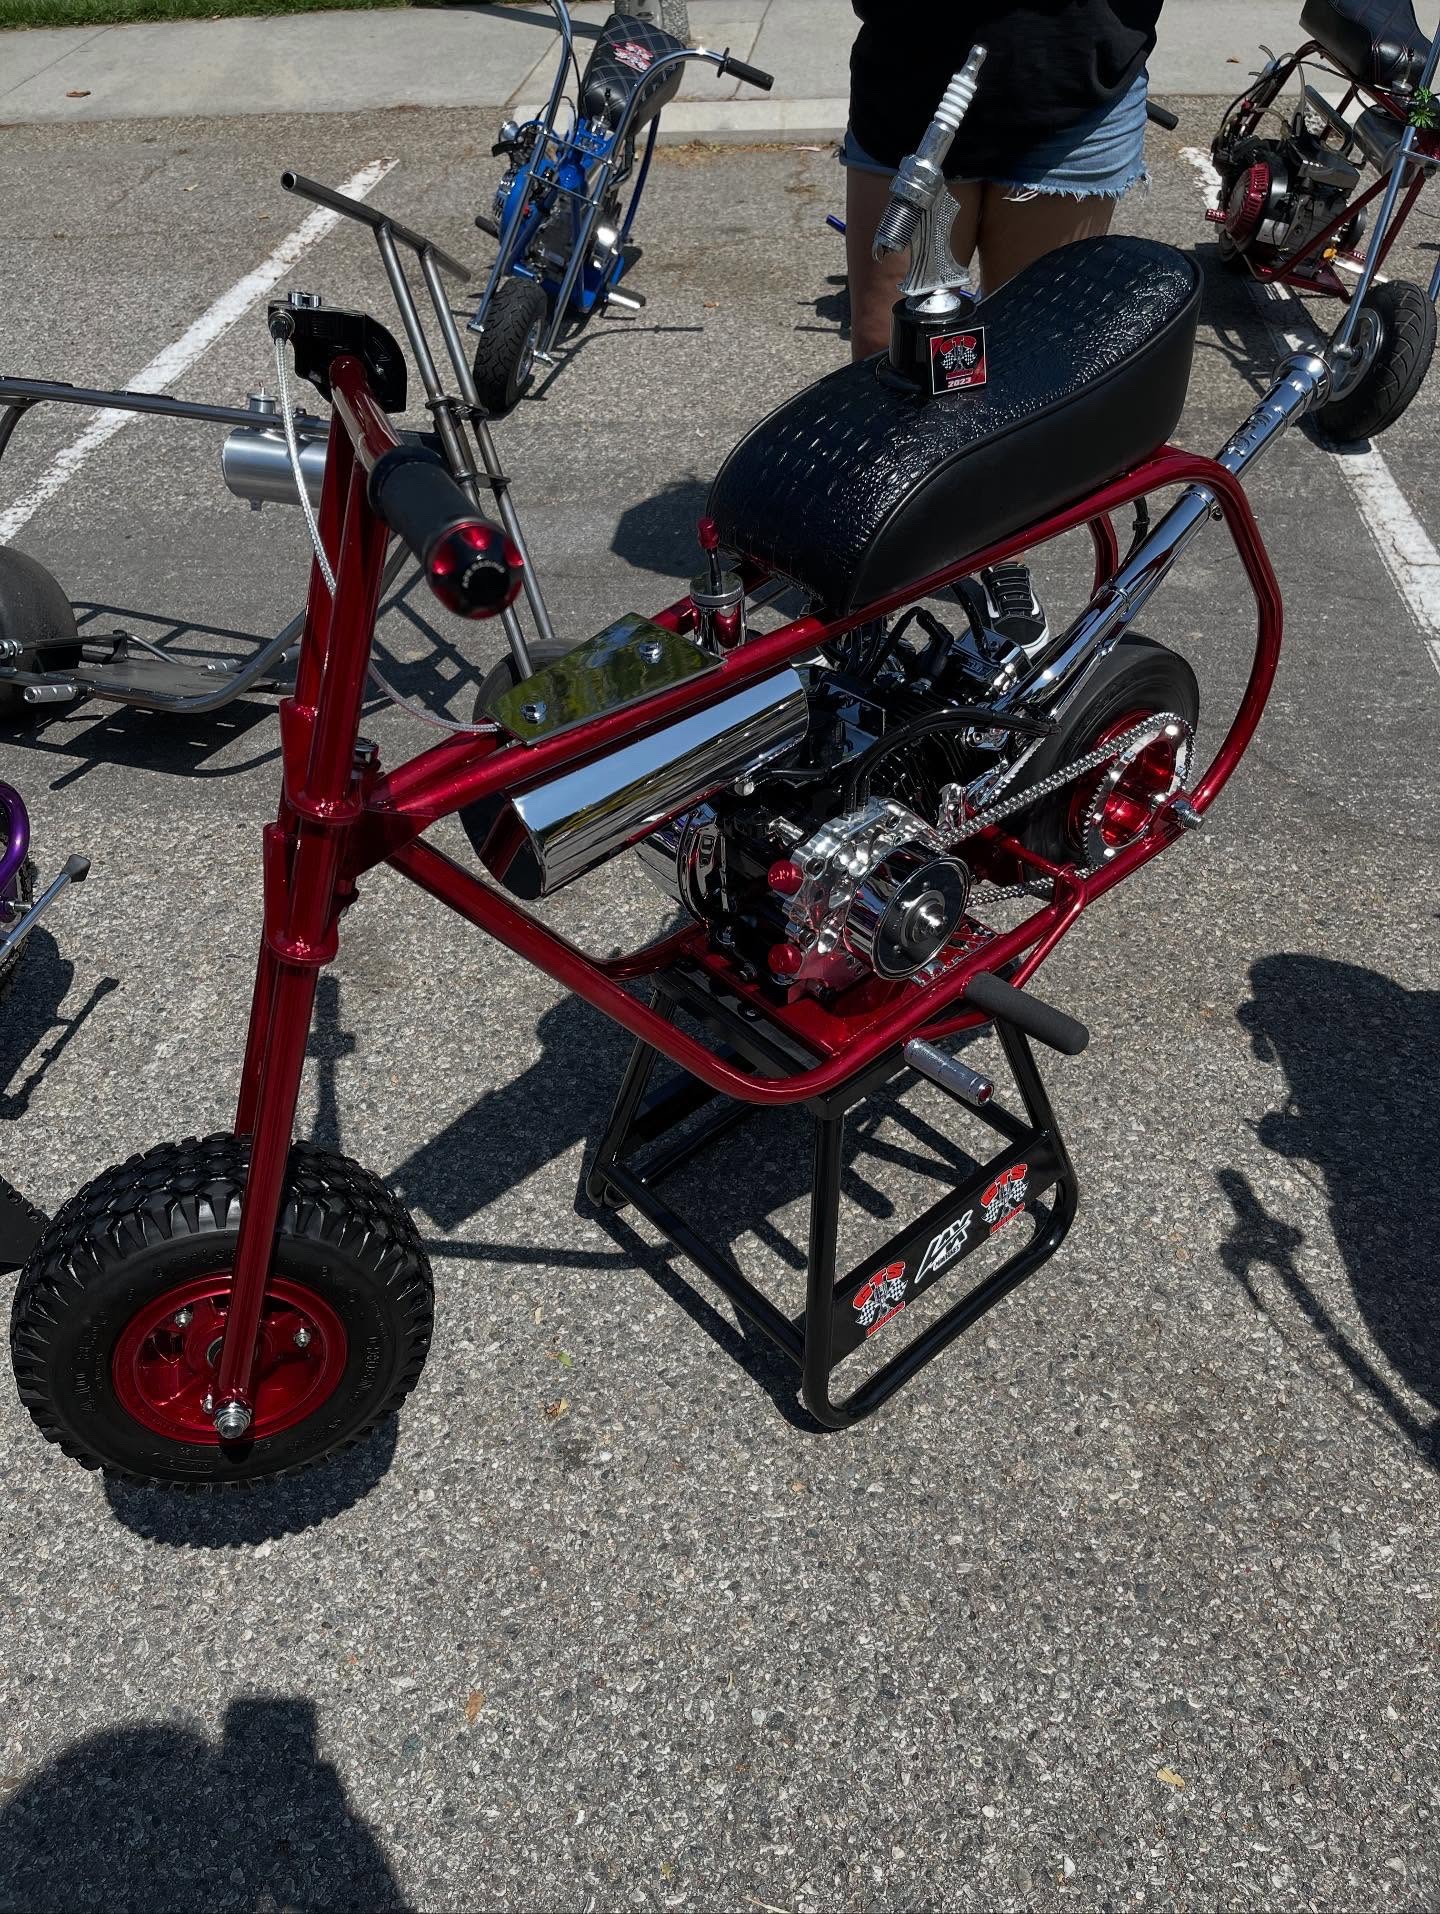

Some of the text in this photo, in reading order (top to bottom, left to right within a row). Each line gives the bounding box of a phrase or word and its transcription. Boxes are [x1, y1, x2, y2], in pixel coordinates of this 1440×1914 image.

[947, 376, 972, 388] 2023
[980, 1164, 1028, 1208] GTS
[853, 1261, 906, 1310] GTS
